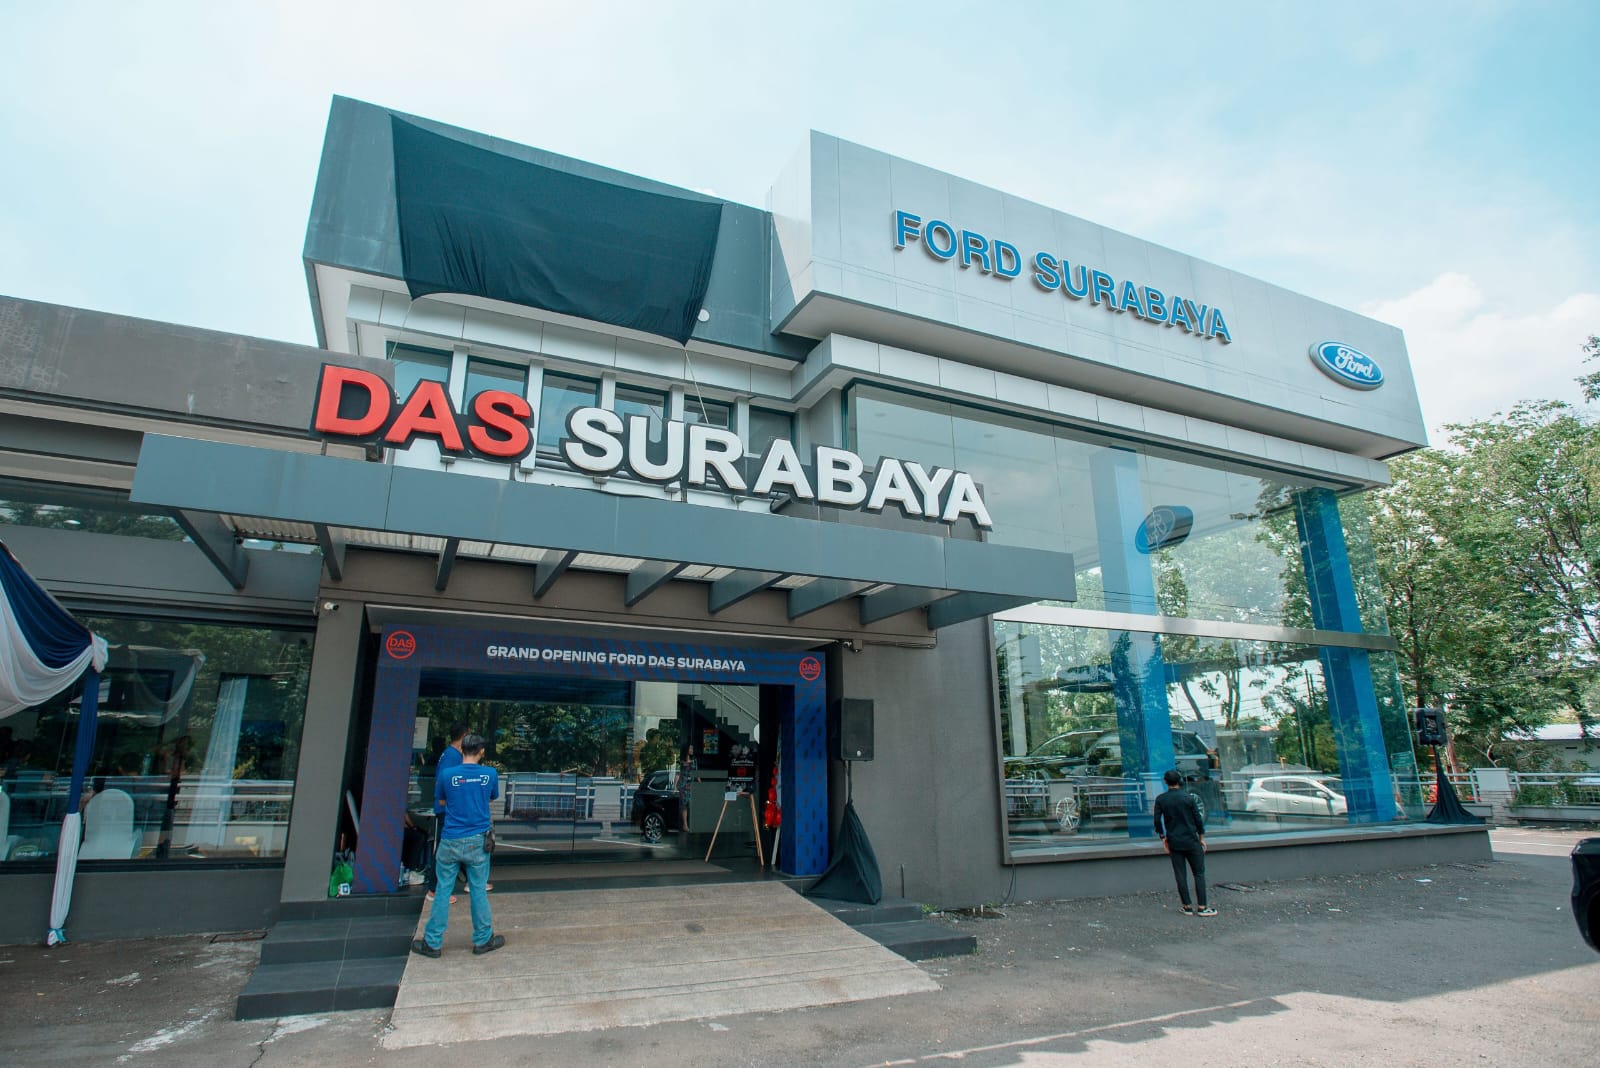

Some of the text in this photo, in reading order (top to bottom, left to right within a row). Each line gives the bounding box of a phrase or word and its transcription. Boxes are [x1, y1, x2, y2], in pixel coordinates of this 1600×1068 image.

[895, 209, 1232, 345] FORD SURABAYA
[1335, 347, 1374, 378] Ford
[313, 364, 993, 528] DAS SURABAYA
[390, 638, 413, 648] DAS
[486, 645, 746, 672] GRAND OPENING FORD DAS SURABAYA
